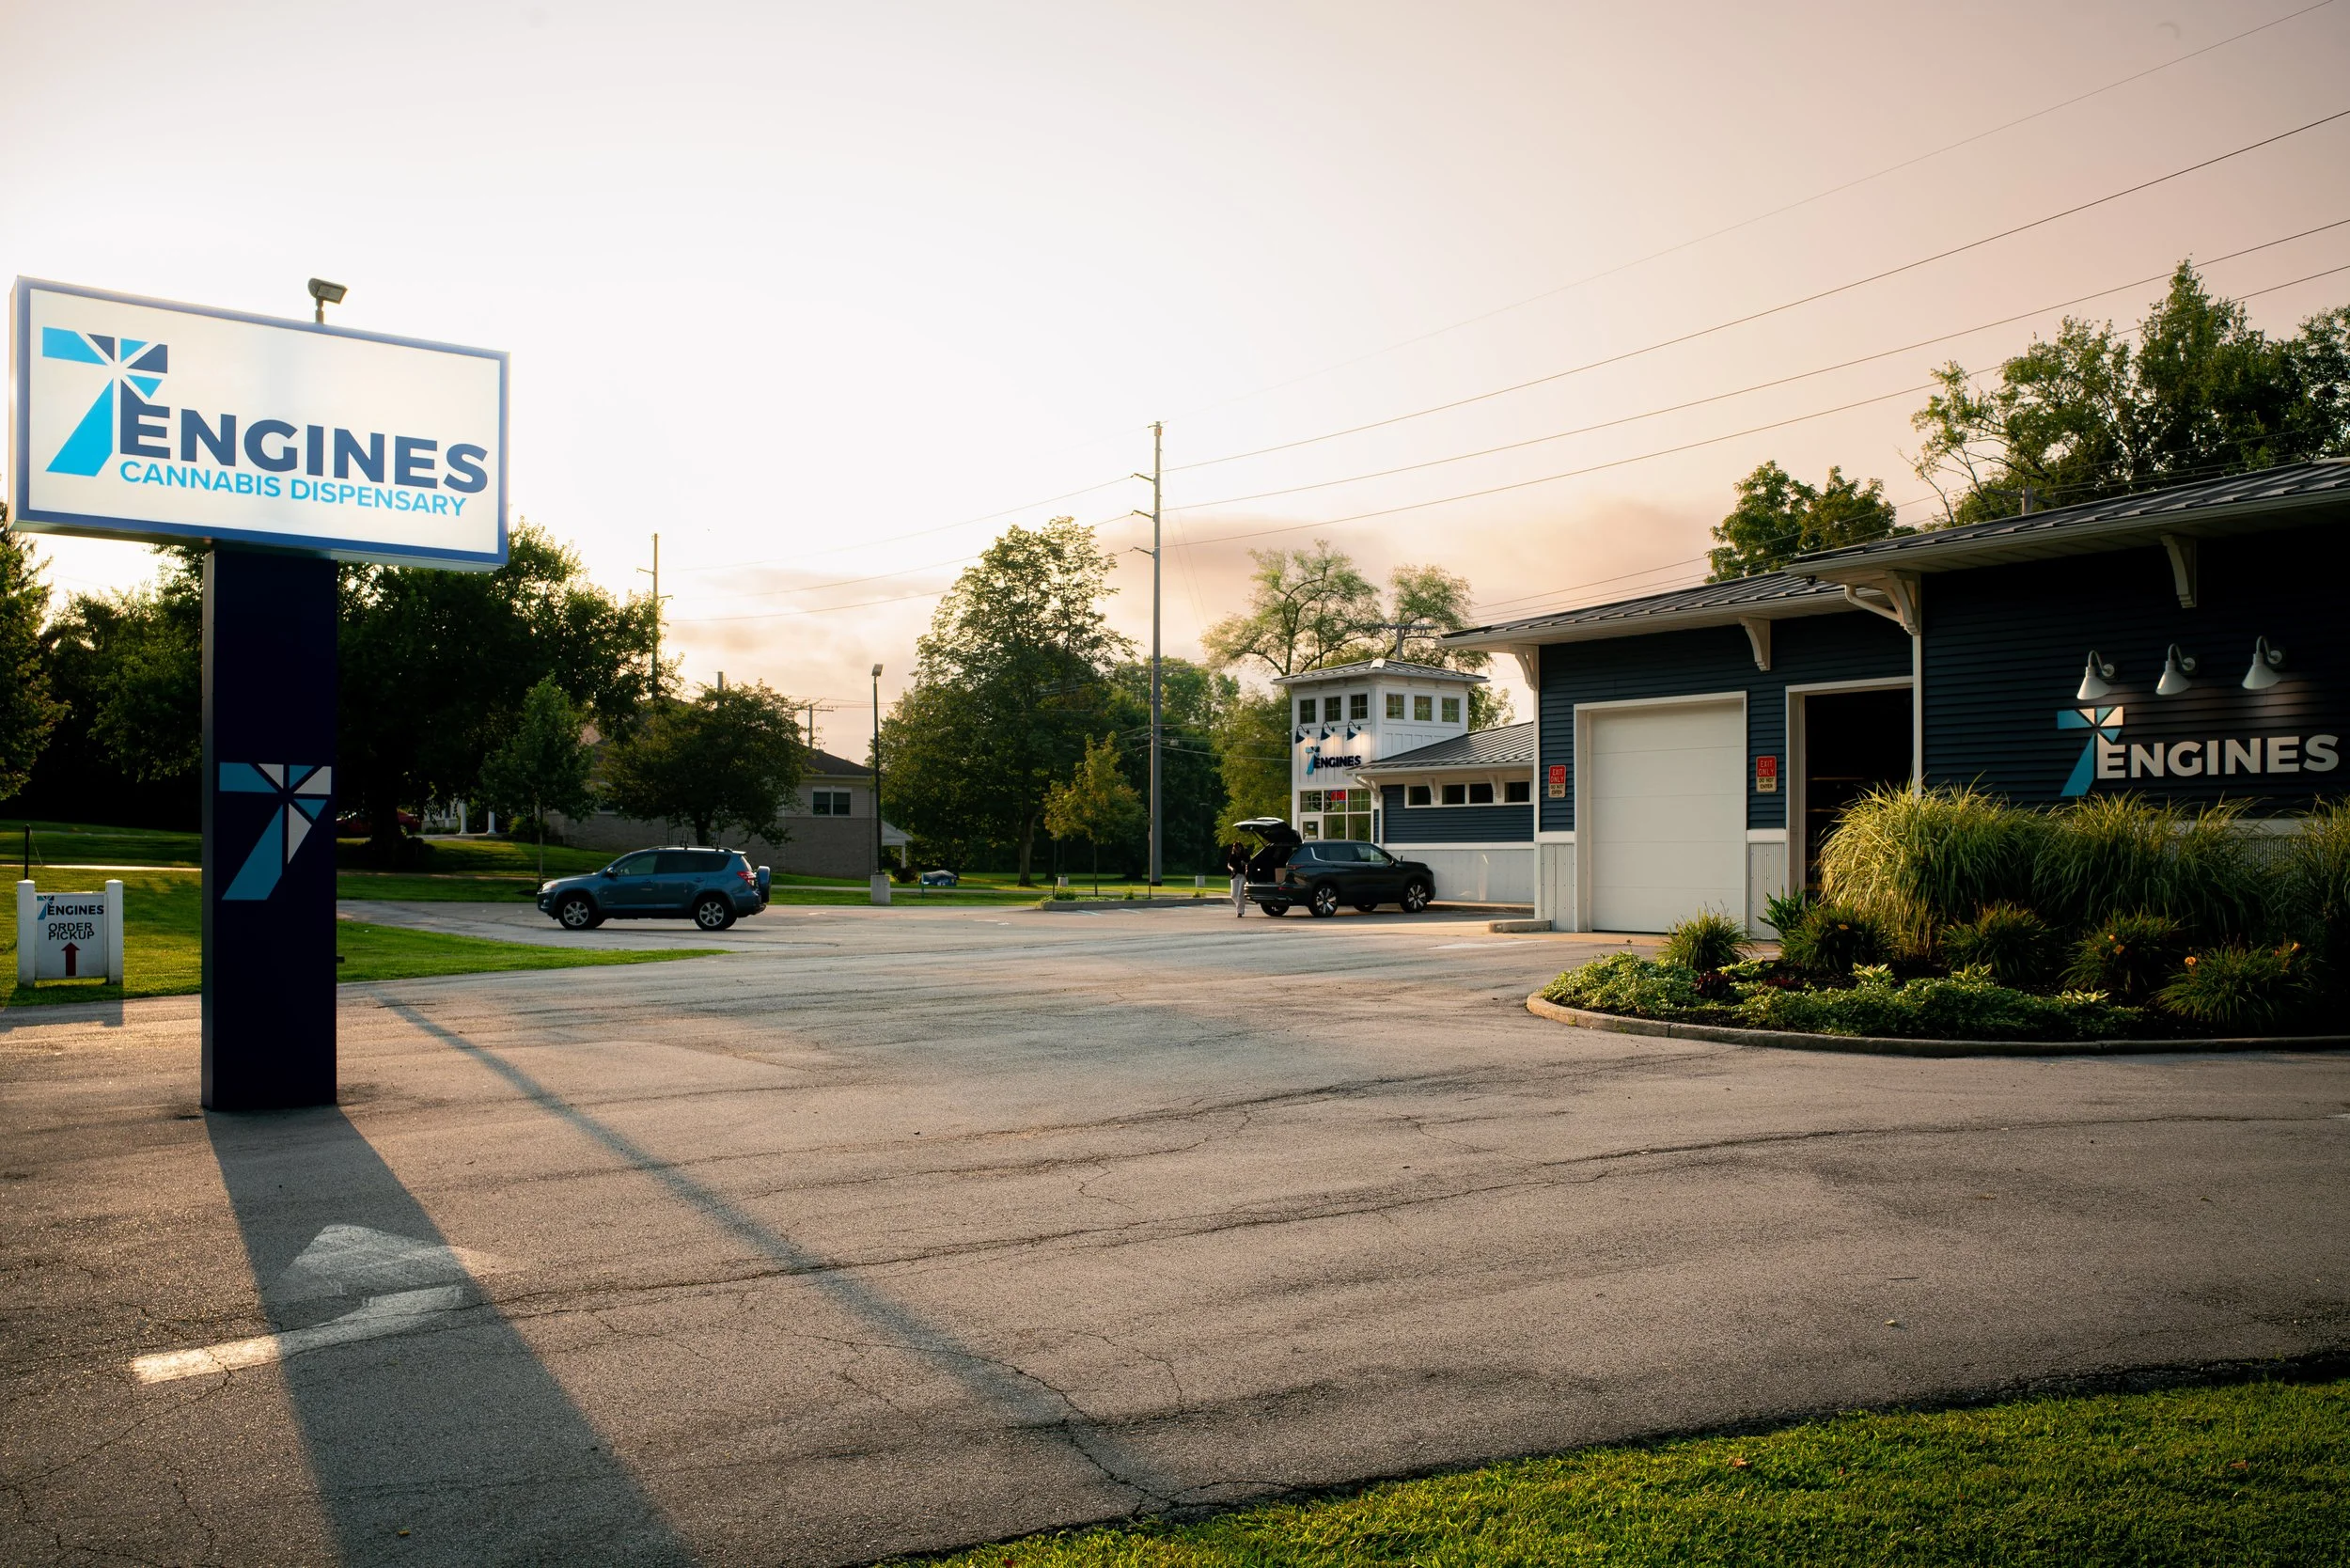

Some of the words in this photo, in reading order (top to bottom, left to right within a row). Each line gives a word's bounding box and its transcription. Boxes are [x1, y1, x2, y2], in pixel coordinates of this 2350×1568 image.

[120, 379, 489, 494] ENGINES
[120, 460, 282, 497] CANNABIS
[290, 478, 467, 516] DISPENSARY
[1313, 755, 1361, 768] ENGINES
[2097, 732, 2340, 779] ENGINES
[1760, 760, 1773, 768] EXIT
[47, 903, 104, 916] ENGINES
[48, 922, 93, 932] ORDER
[48, 931, 95, 941] PICKUP
